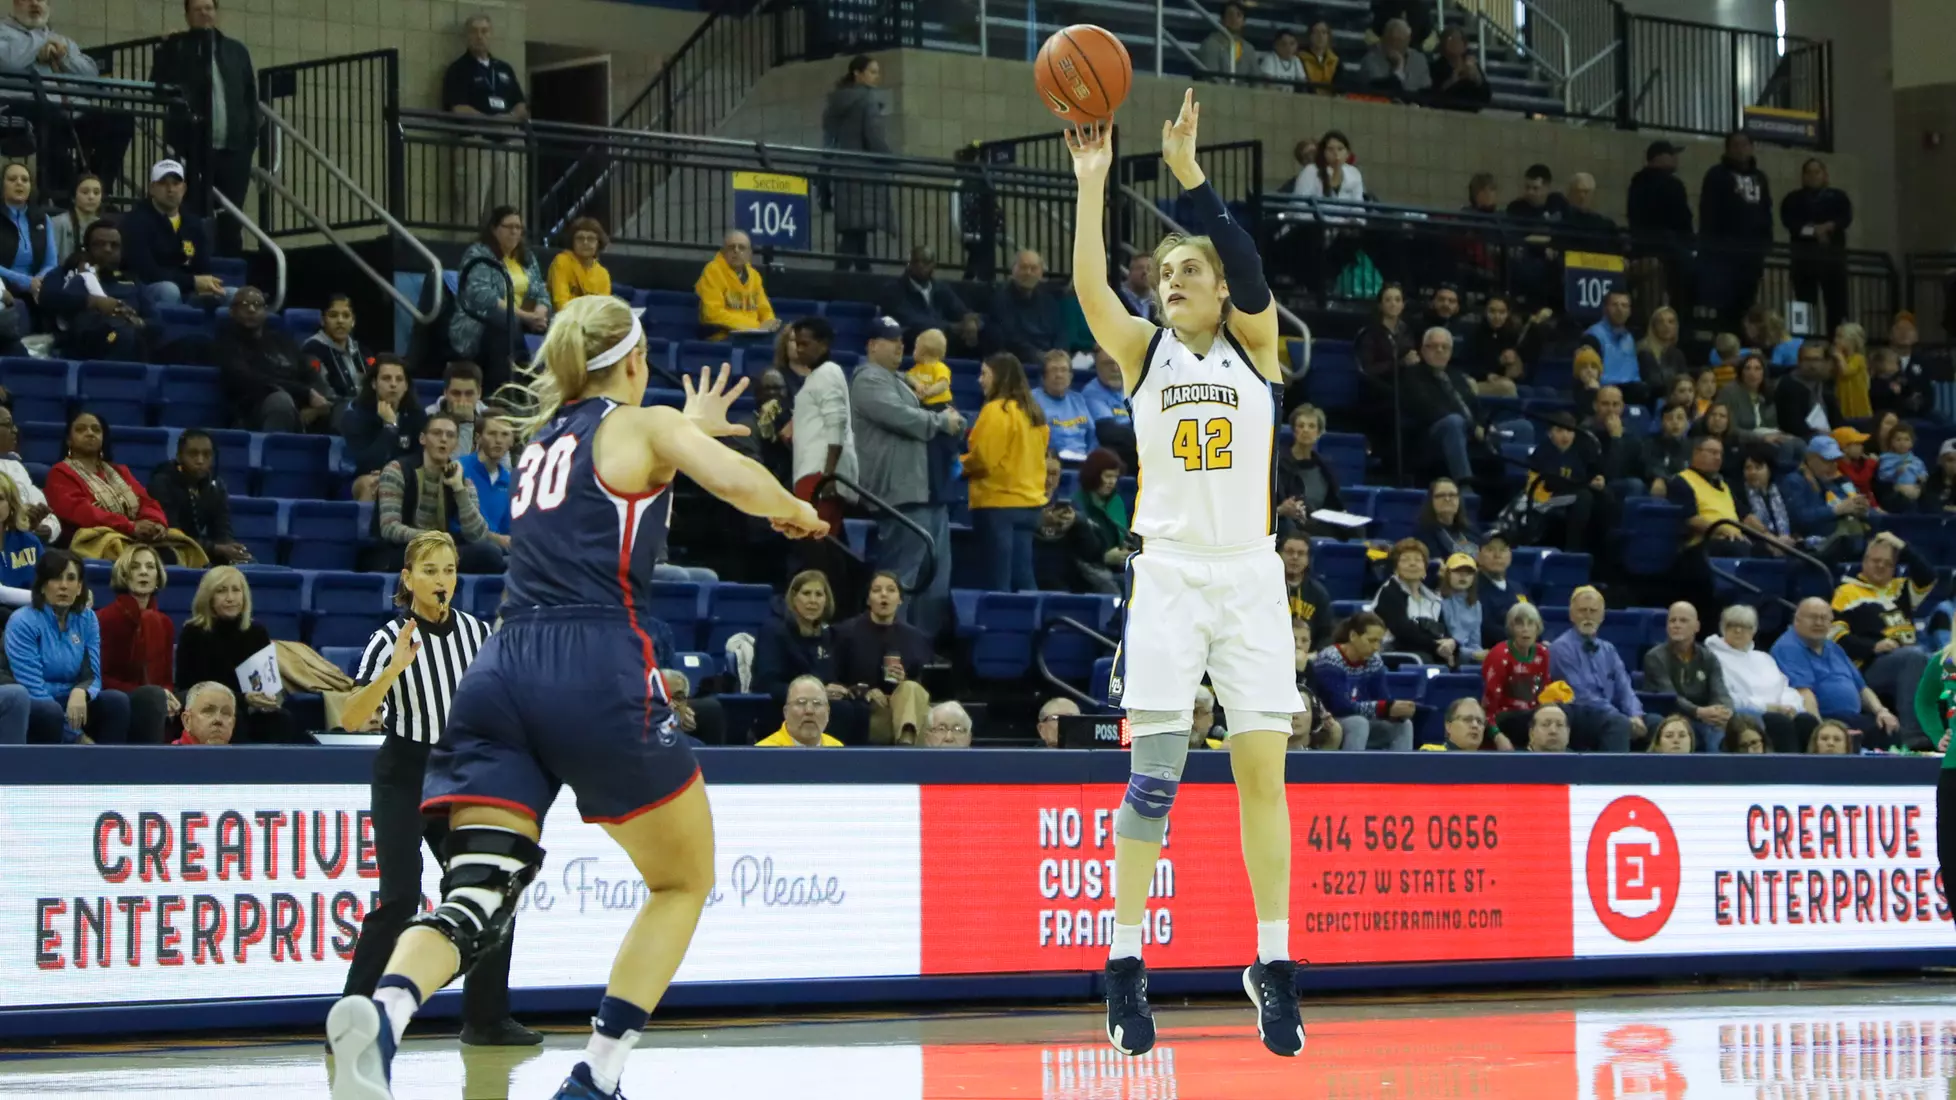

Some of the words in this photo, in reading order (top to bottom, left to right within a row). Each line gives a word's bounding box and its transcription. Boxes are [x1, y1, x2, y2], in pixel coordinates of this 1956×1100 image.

[1058, 54, 1091, 101] ELITE
[752, 174, 792, 191] Section
[749, 201, 797, 238] 104
[1161, 384, 1238, 412] MARQUETTE
[1172, 417, 1232, 471] 42
[510, 432, 578, 520] 30
[1095, 723, 1120, 741] POSS.
[1038, 807, 1082, 848] NO
[1307, 815, 1351, 852] 414
[1364, 815, 1415, 851] 562
[1427, 814, 1498, 850] 0656
[1747, 804, 1921, 860] CREATIVE
[731, 854, 845, 908] Please
[1038, 858, 1175, 899] CUSTM
[1374, 869, 1392, 893] W
[1400, 868, 1456, 893] STATE
[1464, 868, 1486, 893] ST
[1715, 868, 1953, 926] ENTERPRISES
[1306, 908, 1502, 933] CEPICTUREFRAMING.COM
